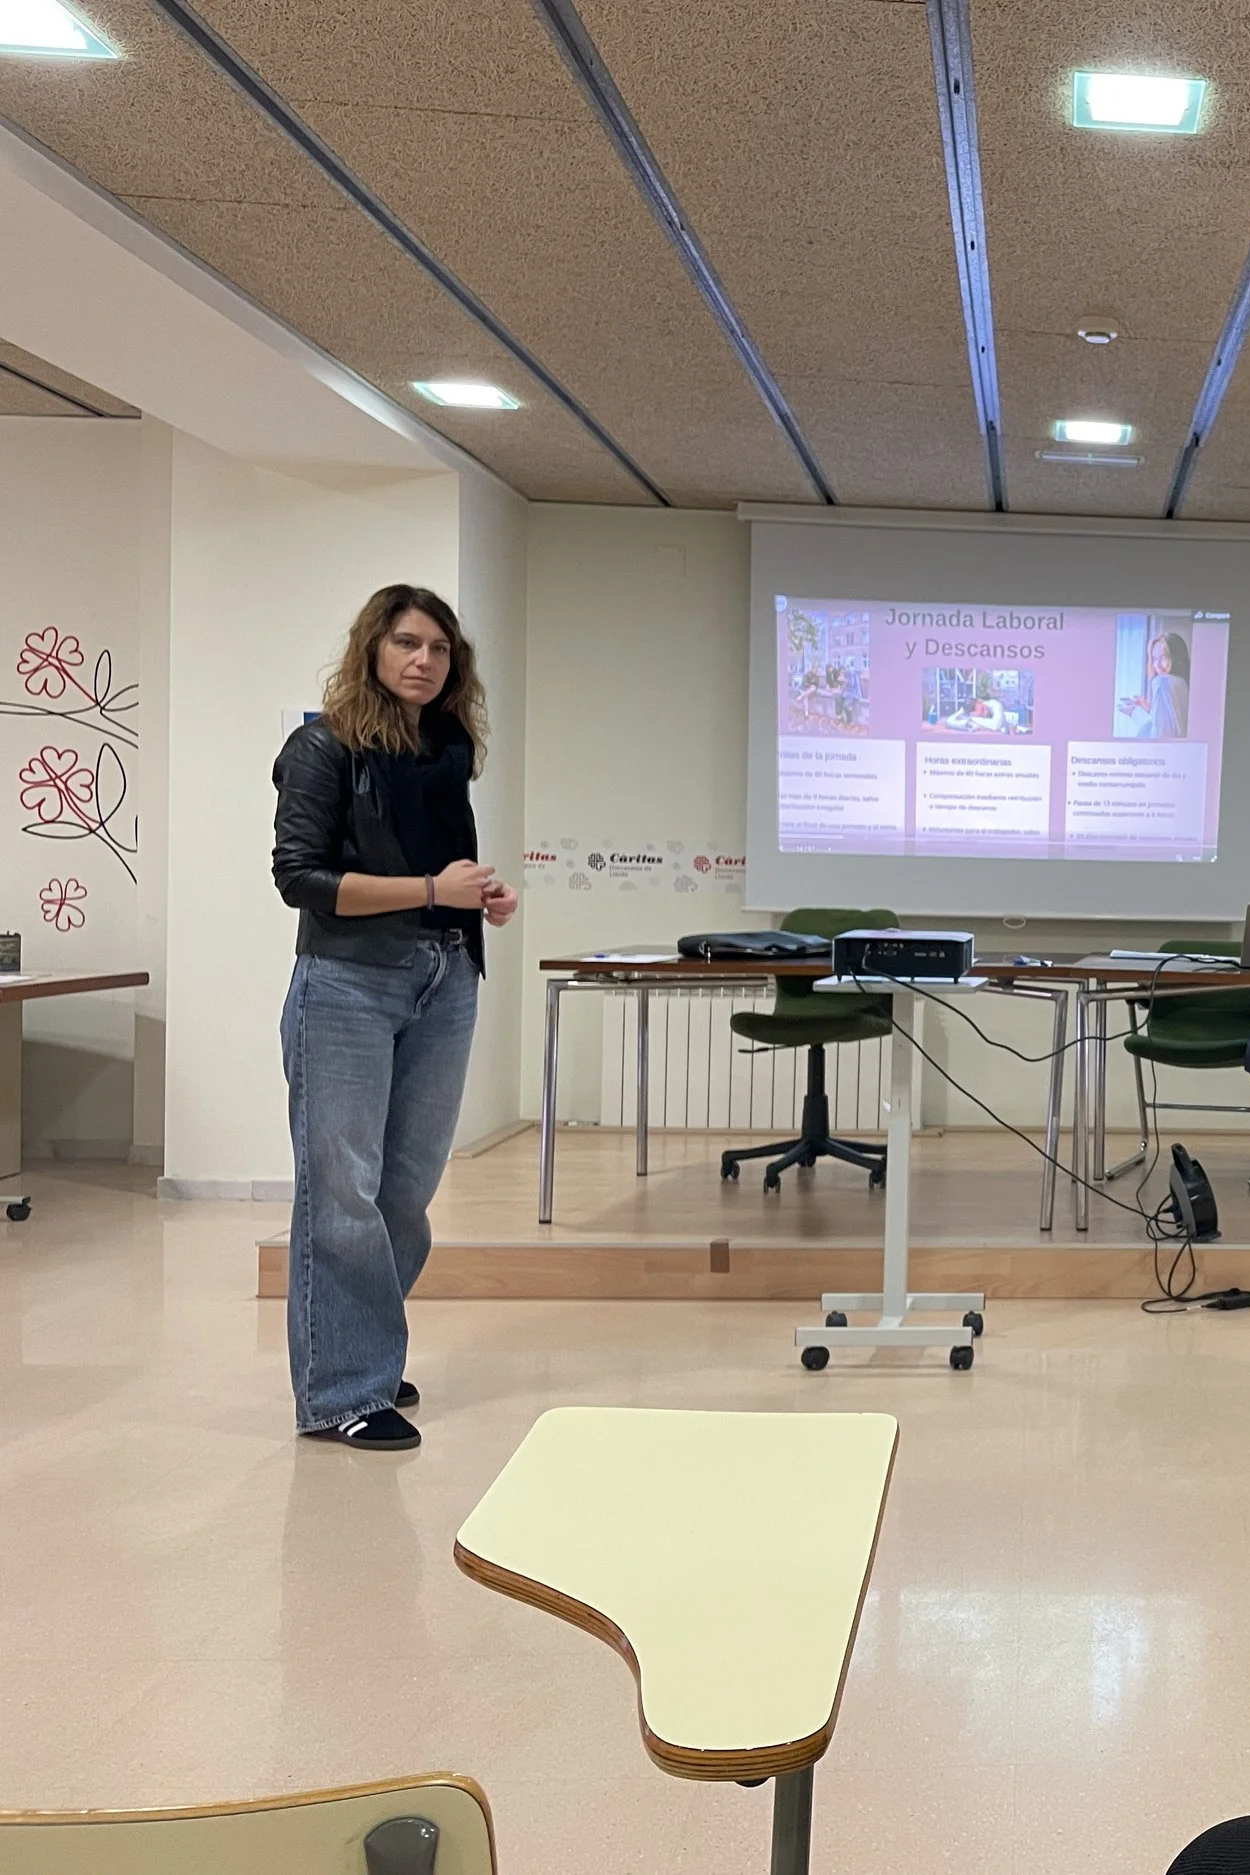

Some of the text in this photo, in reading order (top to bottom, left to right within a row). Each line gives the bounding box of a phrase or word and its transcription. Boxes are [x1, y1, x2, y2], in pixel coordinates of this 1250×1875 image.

[885, 608, 1064, 630] Jornada Laboral
[906, 638, 1045, 659] y Descansos
[825, 752, 857, 762] jornada
[924, 757, 1012, 766] Horas extraordinarias
[1071, 756, 1116, 765] Descansos
[523, 851, 557, 861] ritas
